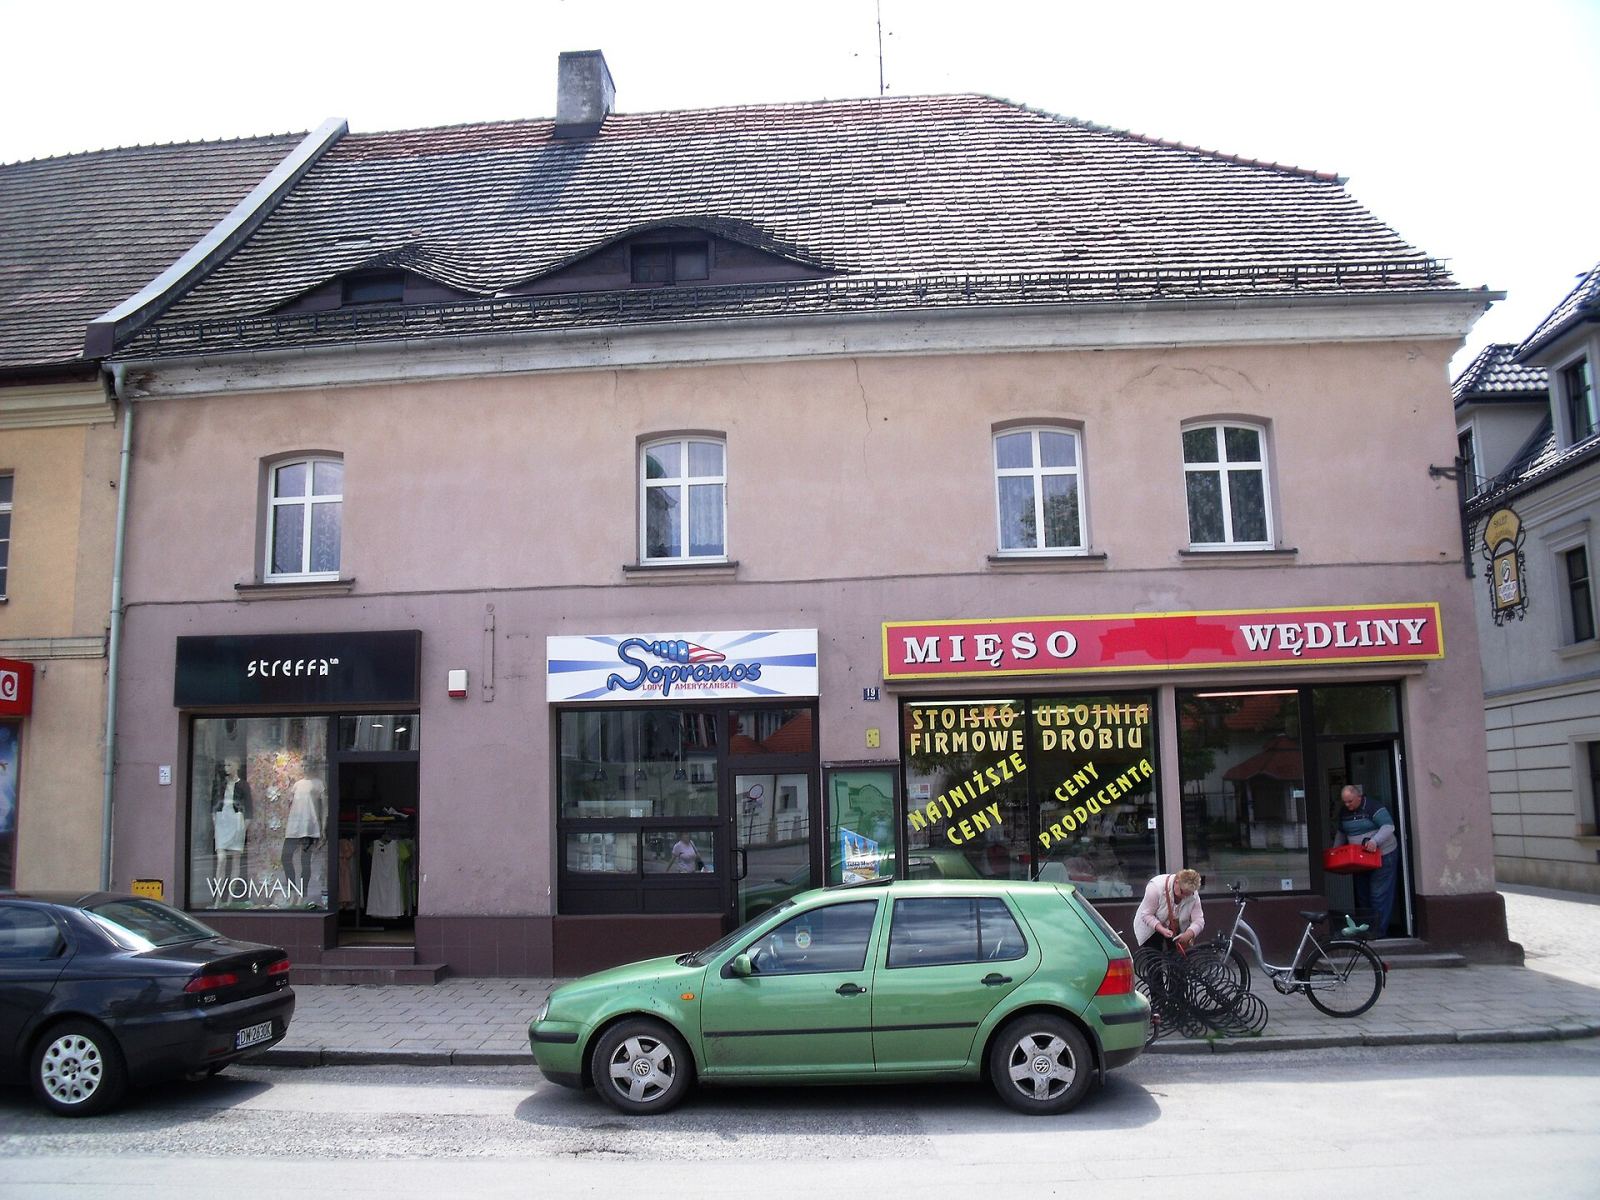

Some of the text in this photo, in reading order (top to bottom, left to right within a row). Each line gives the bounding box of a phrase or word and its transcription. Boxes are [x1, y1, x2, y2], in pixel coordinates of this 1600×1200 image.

[902, 618, 1428, 668] MIĘSO WĘDLINY
[247, 658, 329, 678] streffa
[606, 637, 762, 697] Sopranos
[866, 687, 876, 697] 19
[911, 706, 1015, 730] STOISKO
[1036, 703, 1149, 730] UBOJNIA
[910, 729, 1025, 757] FIRMOWE
[1042, 727, 1143, 753] DROBIU
[907, 752, 1027, 832] NAJNIŻSZE
[1054, 761, 1100, 802] CENY
[1038, 758, 1155, 850] PRODUCENTA
[946, 801, 1003, 846] CENY
[206, 877, 305, 899] WOMAN
